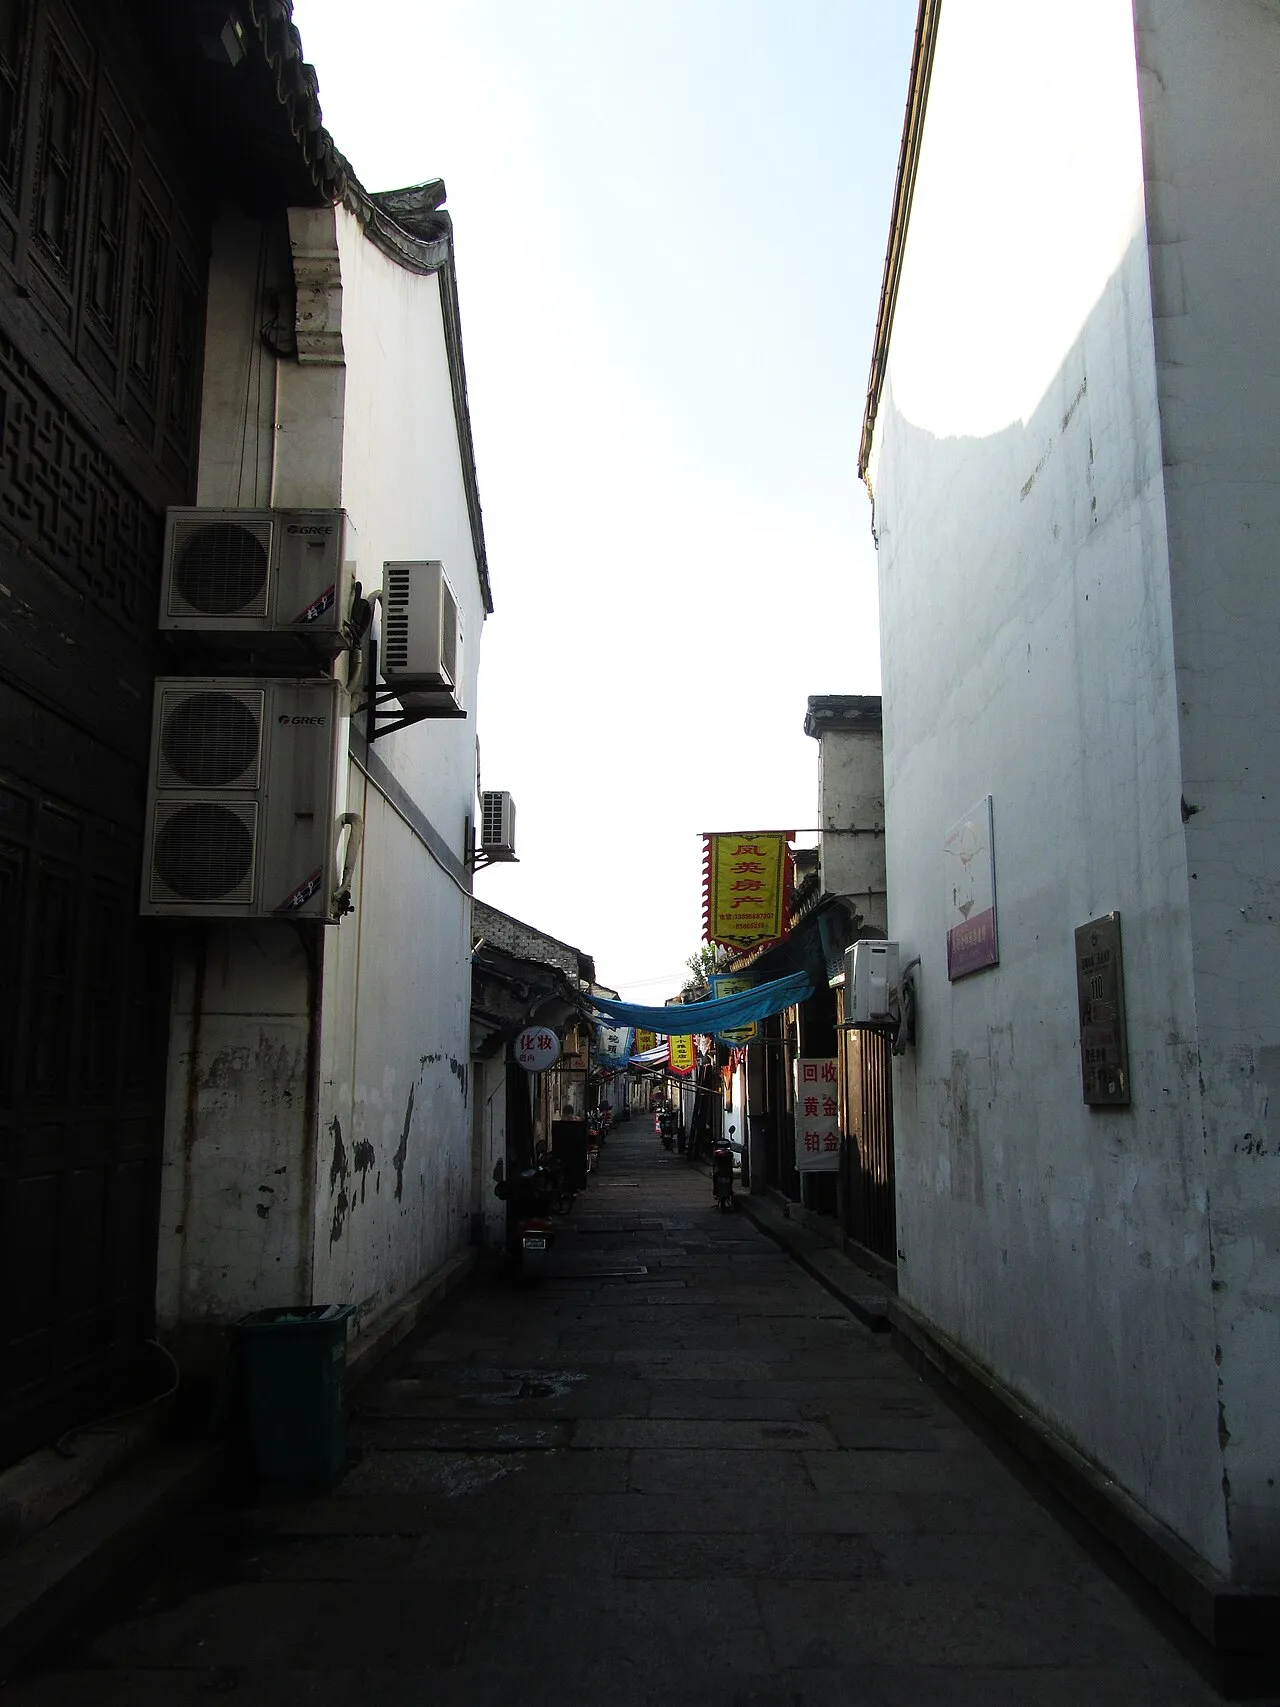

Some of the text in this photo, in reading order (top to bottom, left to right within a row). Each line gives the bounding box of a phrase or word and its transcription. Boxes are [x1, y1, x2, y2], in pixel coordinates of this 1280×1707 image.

[300, 526, 333, 535] GREE
[292, 716, 326, 725] GREE
[1091, 975, 1104, 1000] 110
[520, 1034, 553, 1050] 化妆
[803, 1061, 838, 1083] 回收
[804, 1096, 838, 1117] 黄金
[804, 1132, 839, 1153] 铂金
